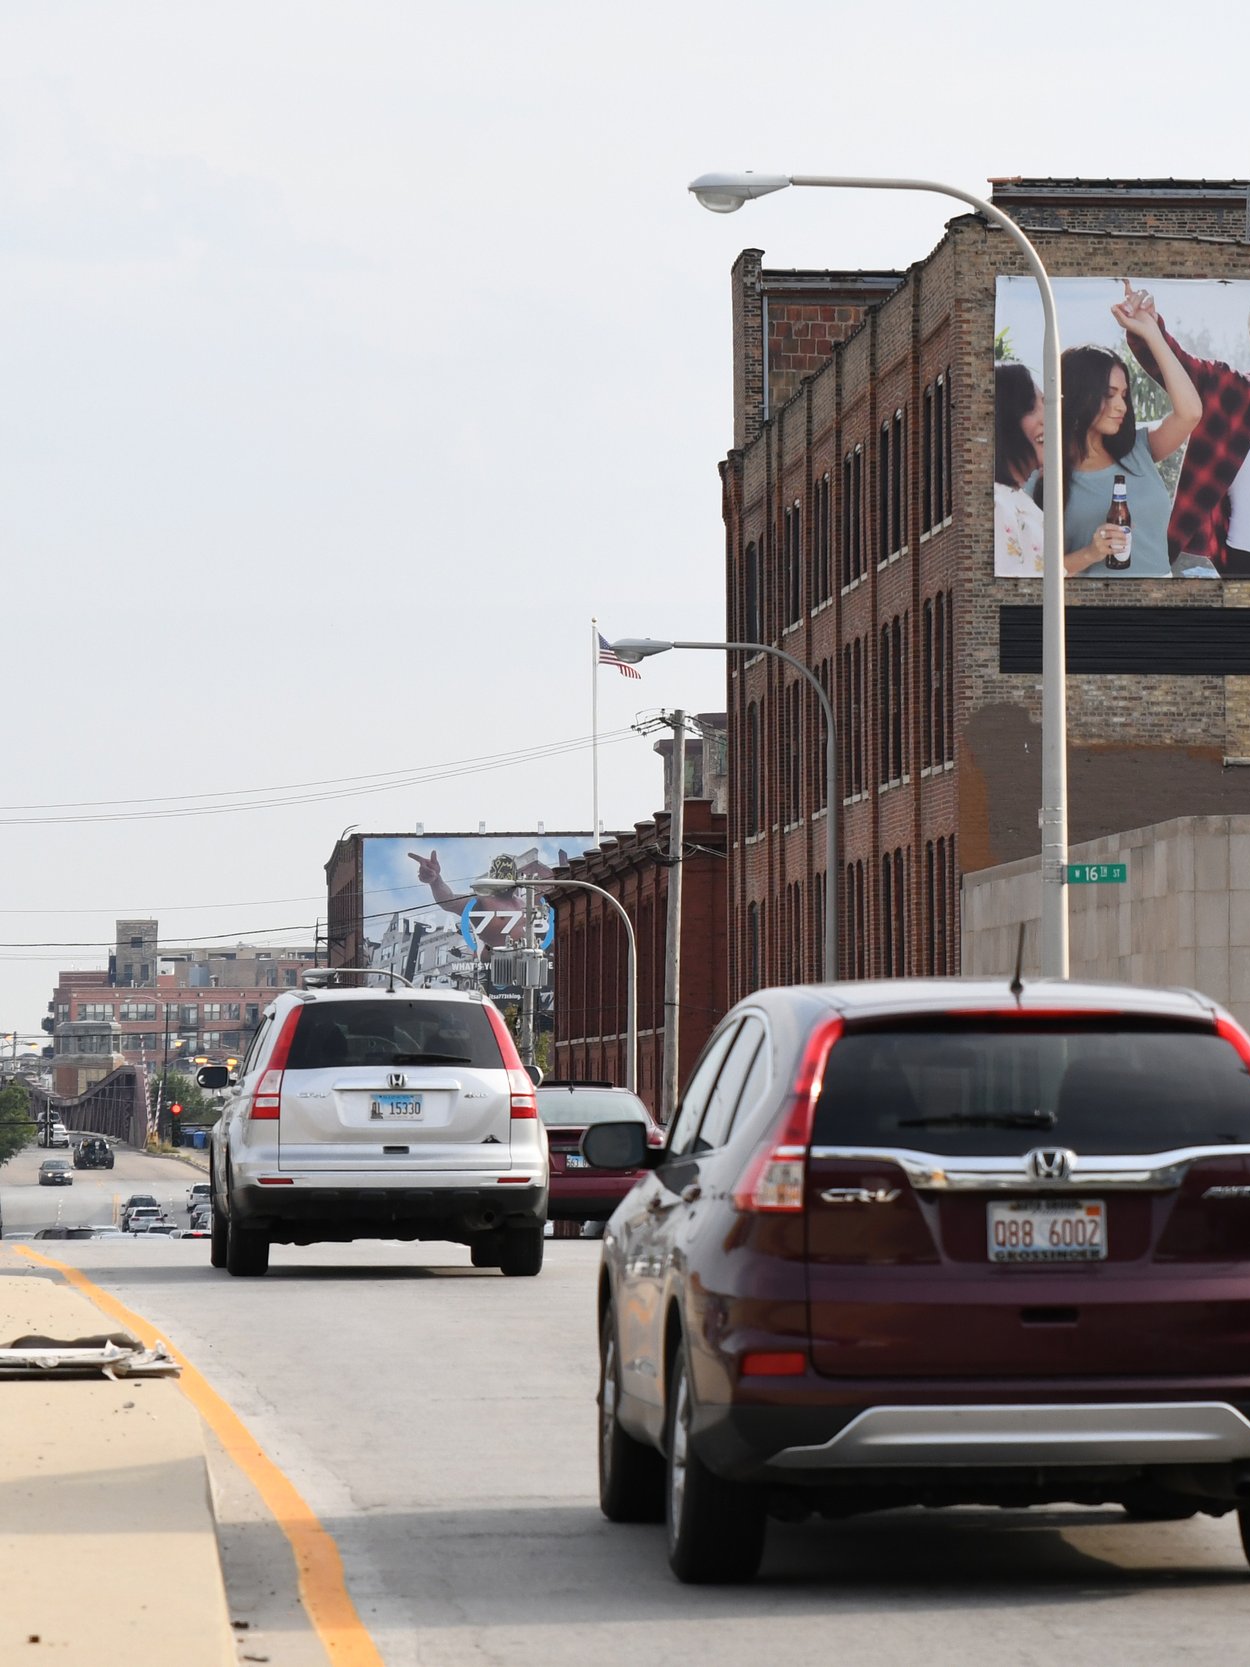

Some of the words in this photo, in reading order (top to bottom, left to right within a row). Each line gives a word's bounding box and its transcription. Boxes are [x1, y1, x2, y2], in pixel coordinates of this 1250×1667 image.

[1113, 869, 1120, 878] ST
[389, 1101, 421, 1115] 15330
[995, 1219, 1033, 1248] Q88
[1048, 1219, 1099, 1248] 6002
